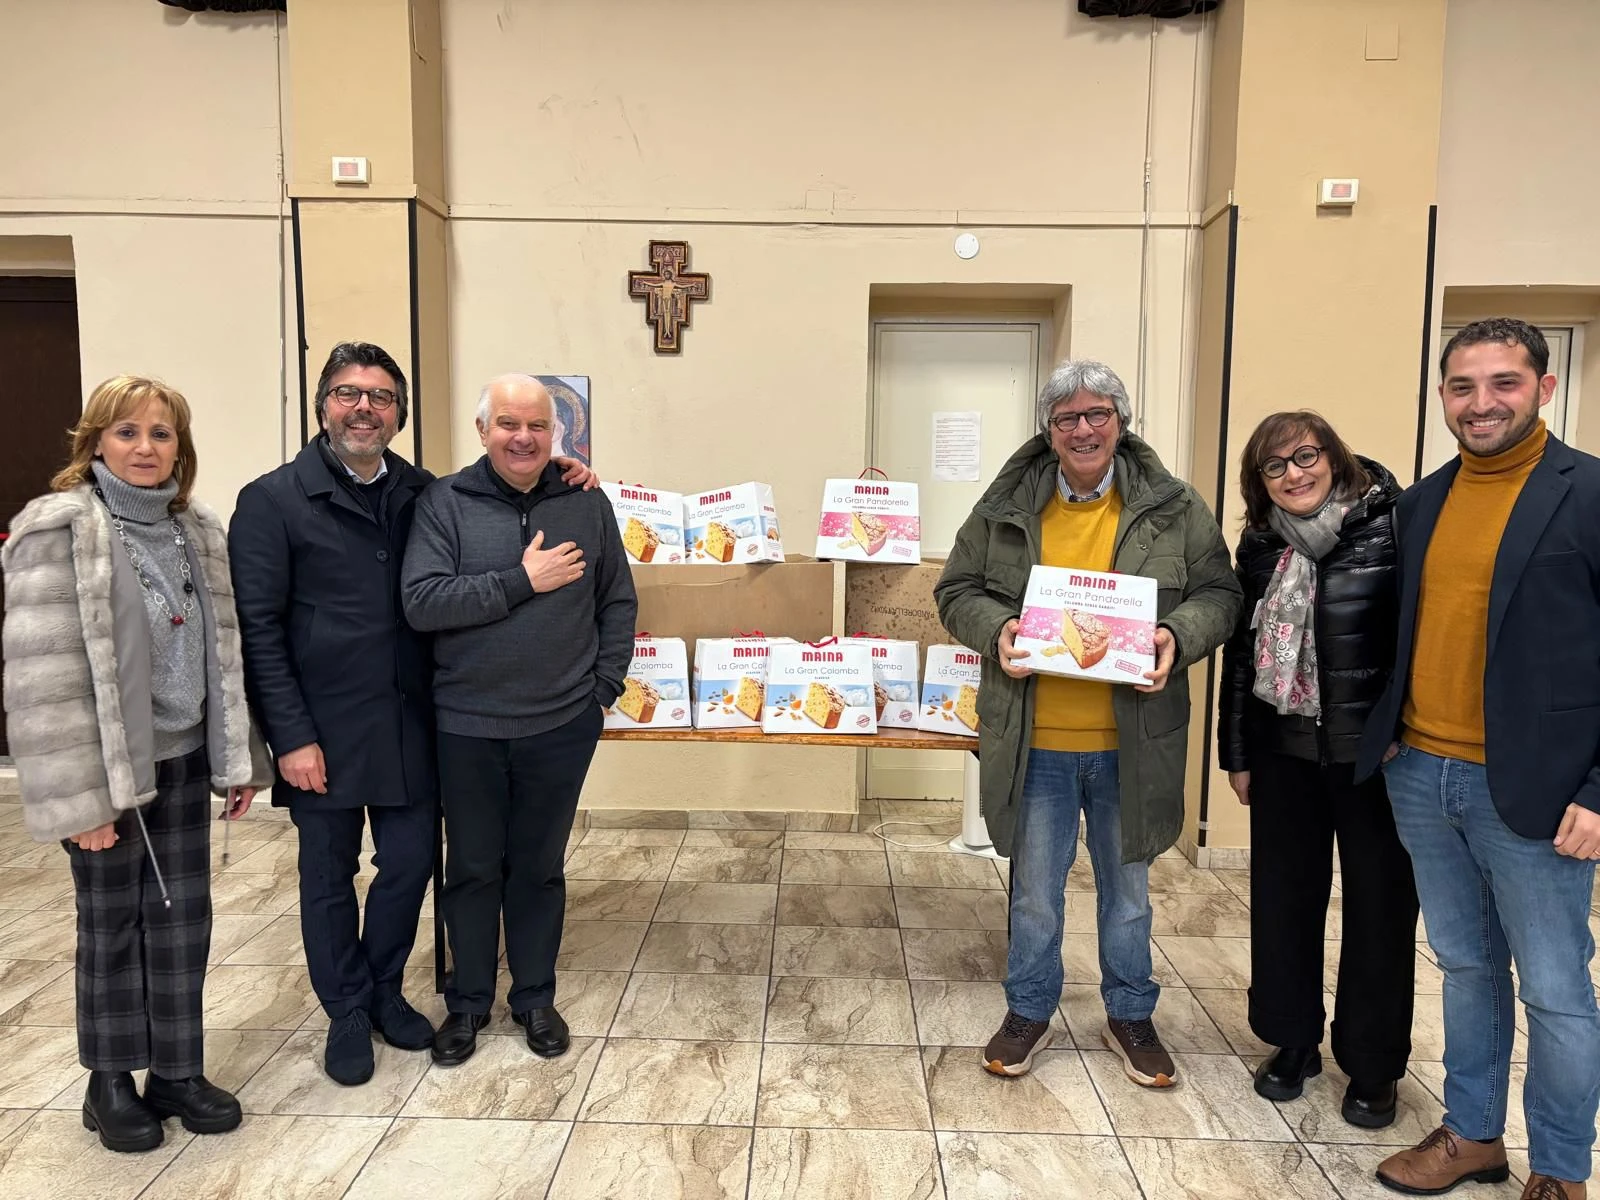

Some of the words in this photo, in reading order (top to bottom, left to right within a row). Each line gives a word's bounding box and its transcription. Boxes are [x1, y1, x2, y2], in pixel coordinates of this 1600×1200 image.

[620, 489, 657, 502] MAINA
[854, 485, 889, 495] MAINA
[699, 491, 731, 506] MAINA
[845, 496, 864, 504] Gran
[866, 497, 909, 506] Pandorella
[616, 502, 635, 510] Gran
[637, 504, 672, 516] Colomba
[697, 510, 713, 518] Gran
[715, 503, 745, 514] Colomba
[1069, 575, 1116, 590] MAINA
[1040, 586, 1052, 595] La
[1055, 588, 1081, 600] Gran
[1084, 591, 1142, 607] Pandorella
[635, 647, 656, 657] INA
[802, 651, 843, 662] MAINA
[955, 654, 981, 665] MAI
[729, 662, 749, 670] Gran
[797, 666, 817, 674] Gran
[820, 666, 858, 674] Colomba
[949, 668, 969, 677] Gran
